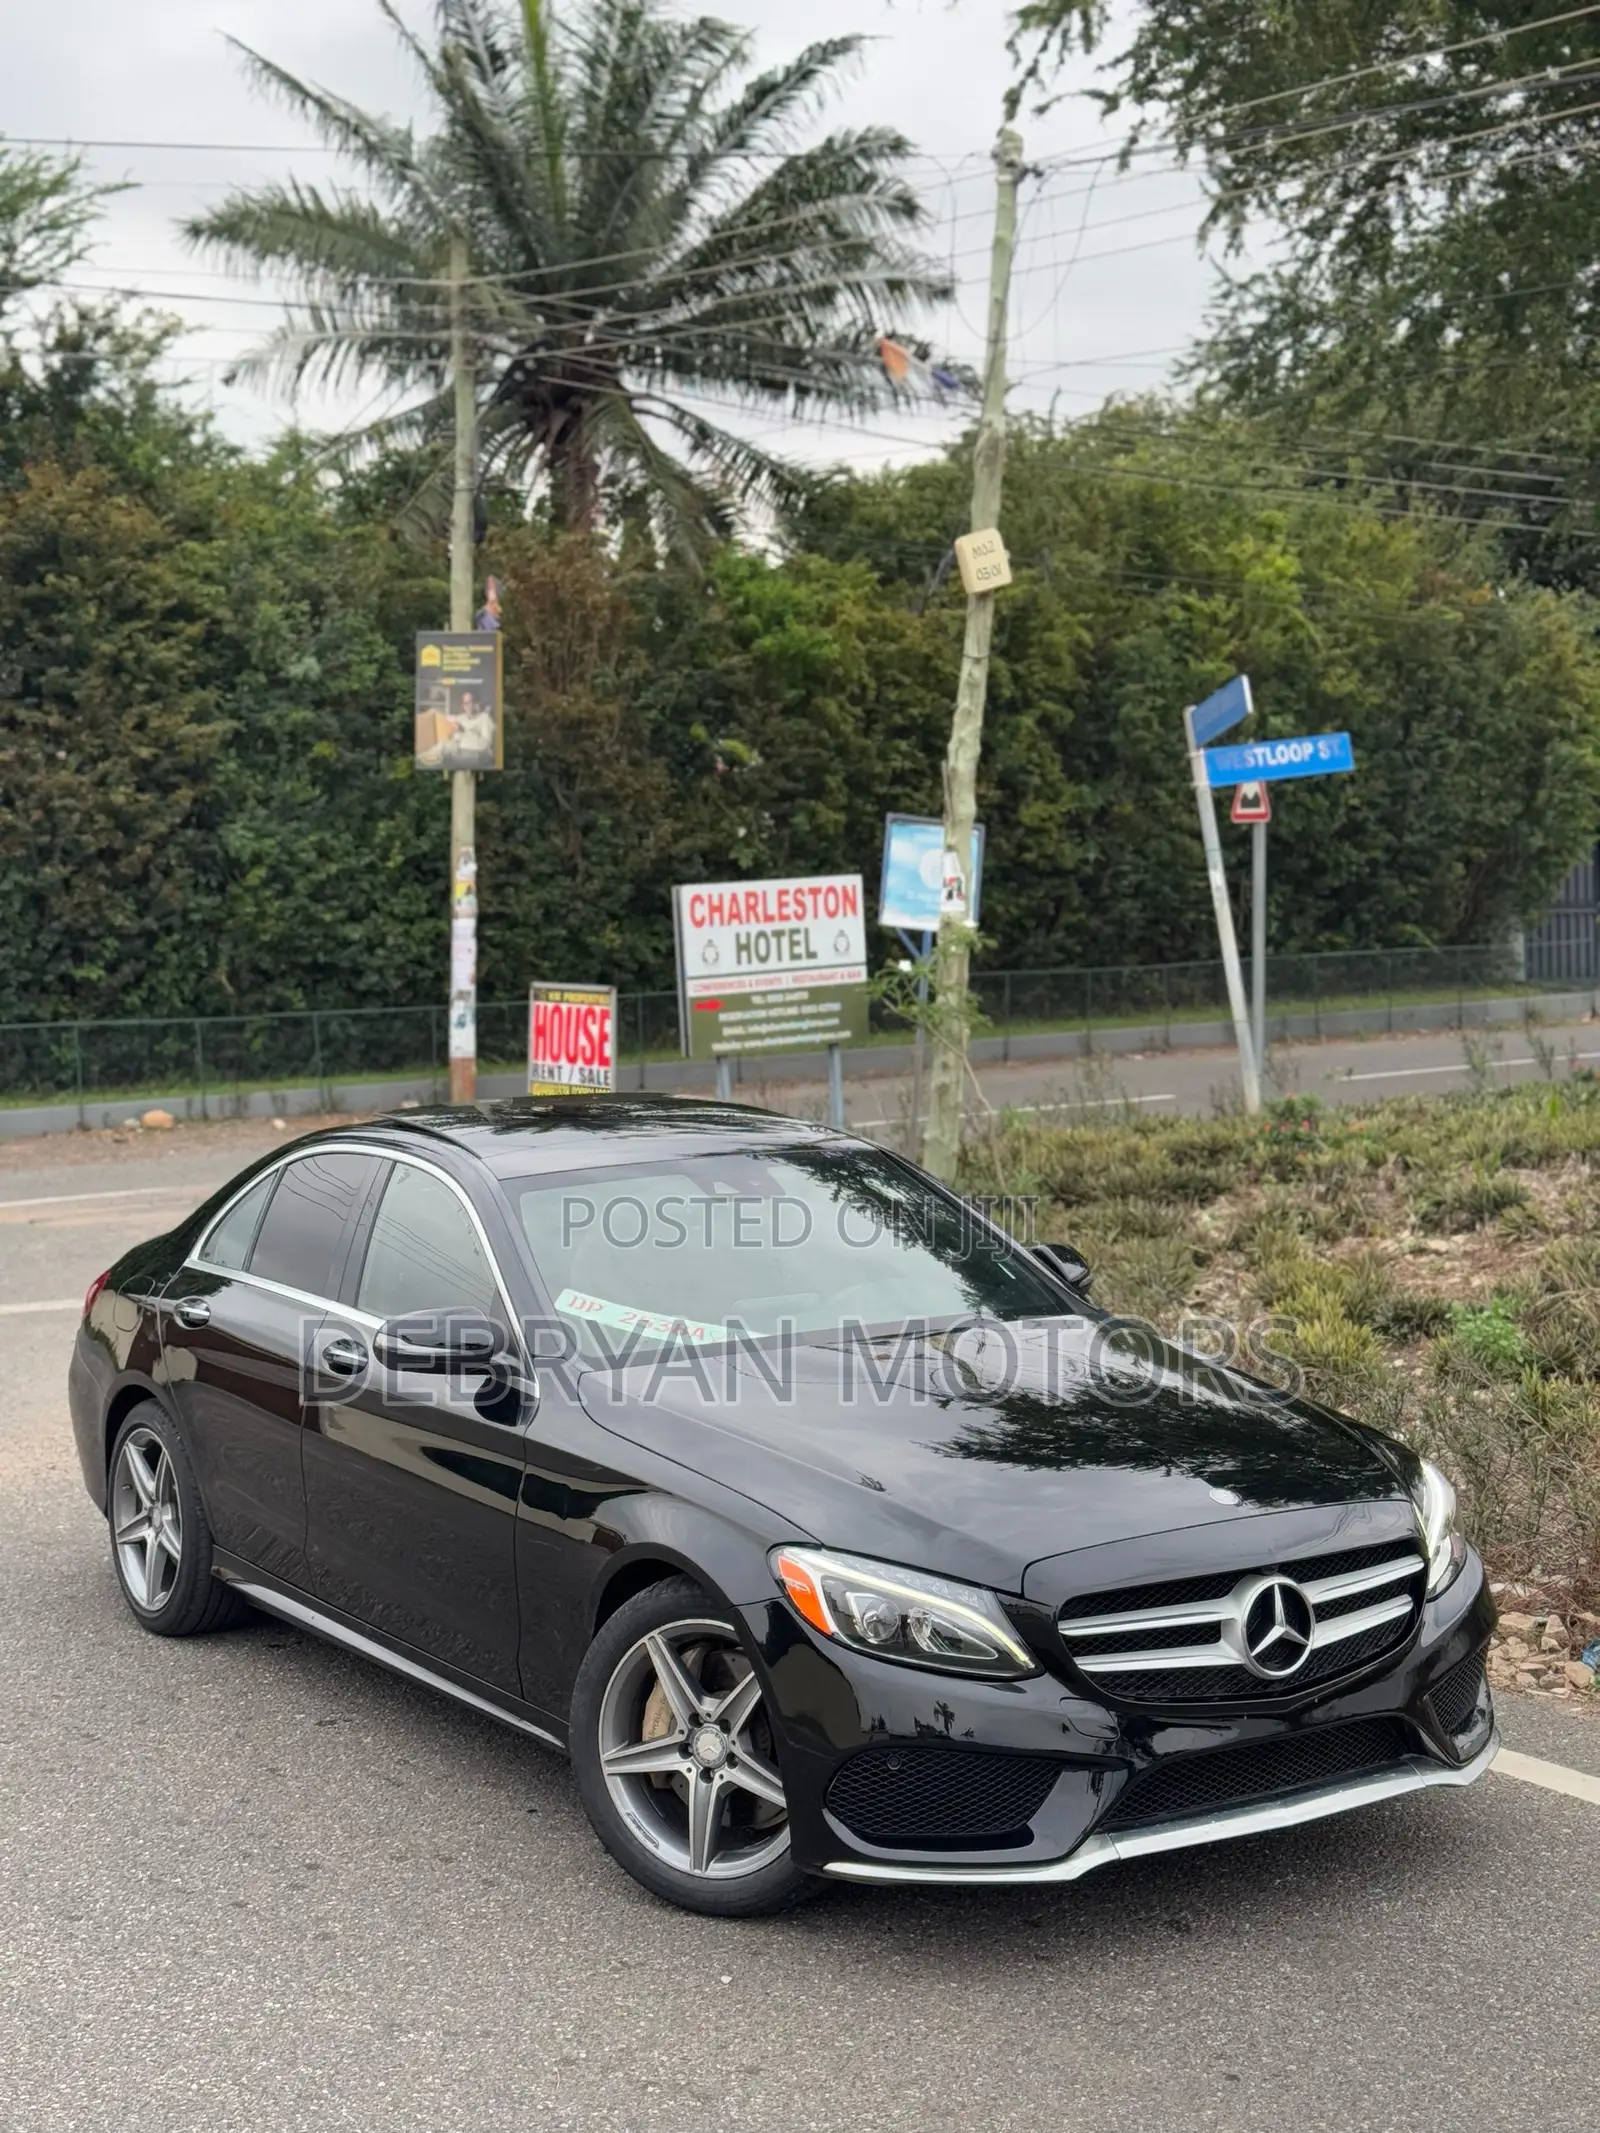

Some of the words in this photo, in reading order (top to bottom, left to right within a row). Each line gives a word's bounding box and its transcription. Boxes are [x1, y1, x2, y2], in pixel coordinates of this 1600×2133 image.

[689, 884, 858, 929] CHARLESTON
[735, 927, 818, 965] HOTEL
[533, 1003, 611, 1067] HOUSE
[532, 1063, 562, 1081] RENT
[579, 1067, 611, 1086] SALE
